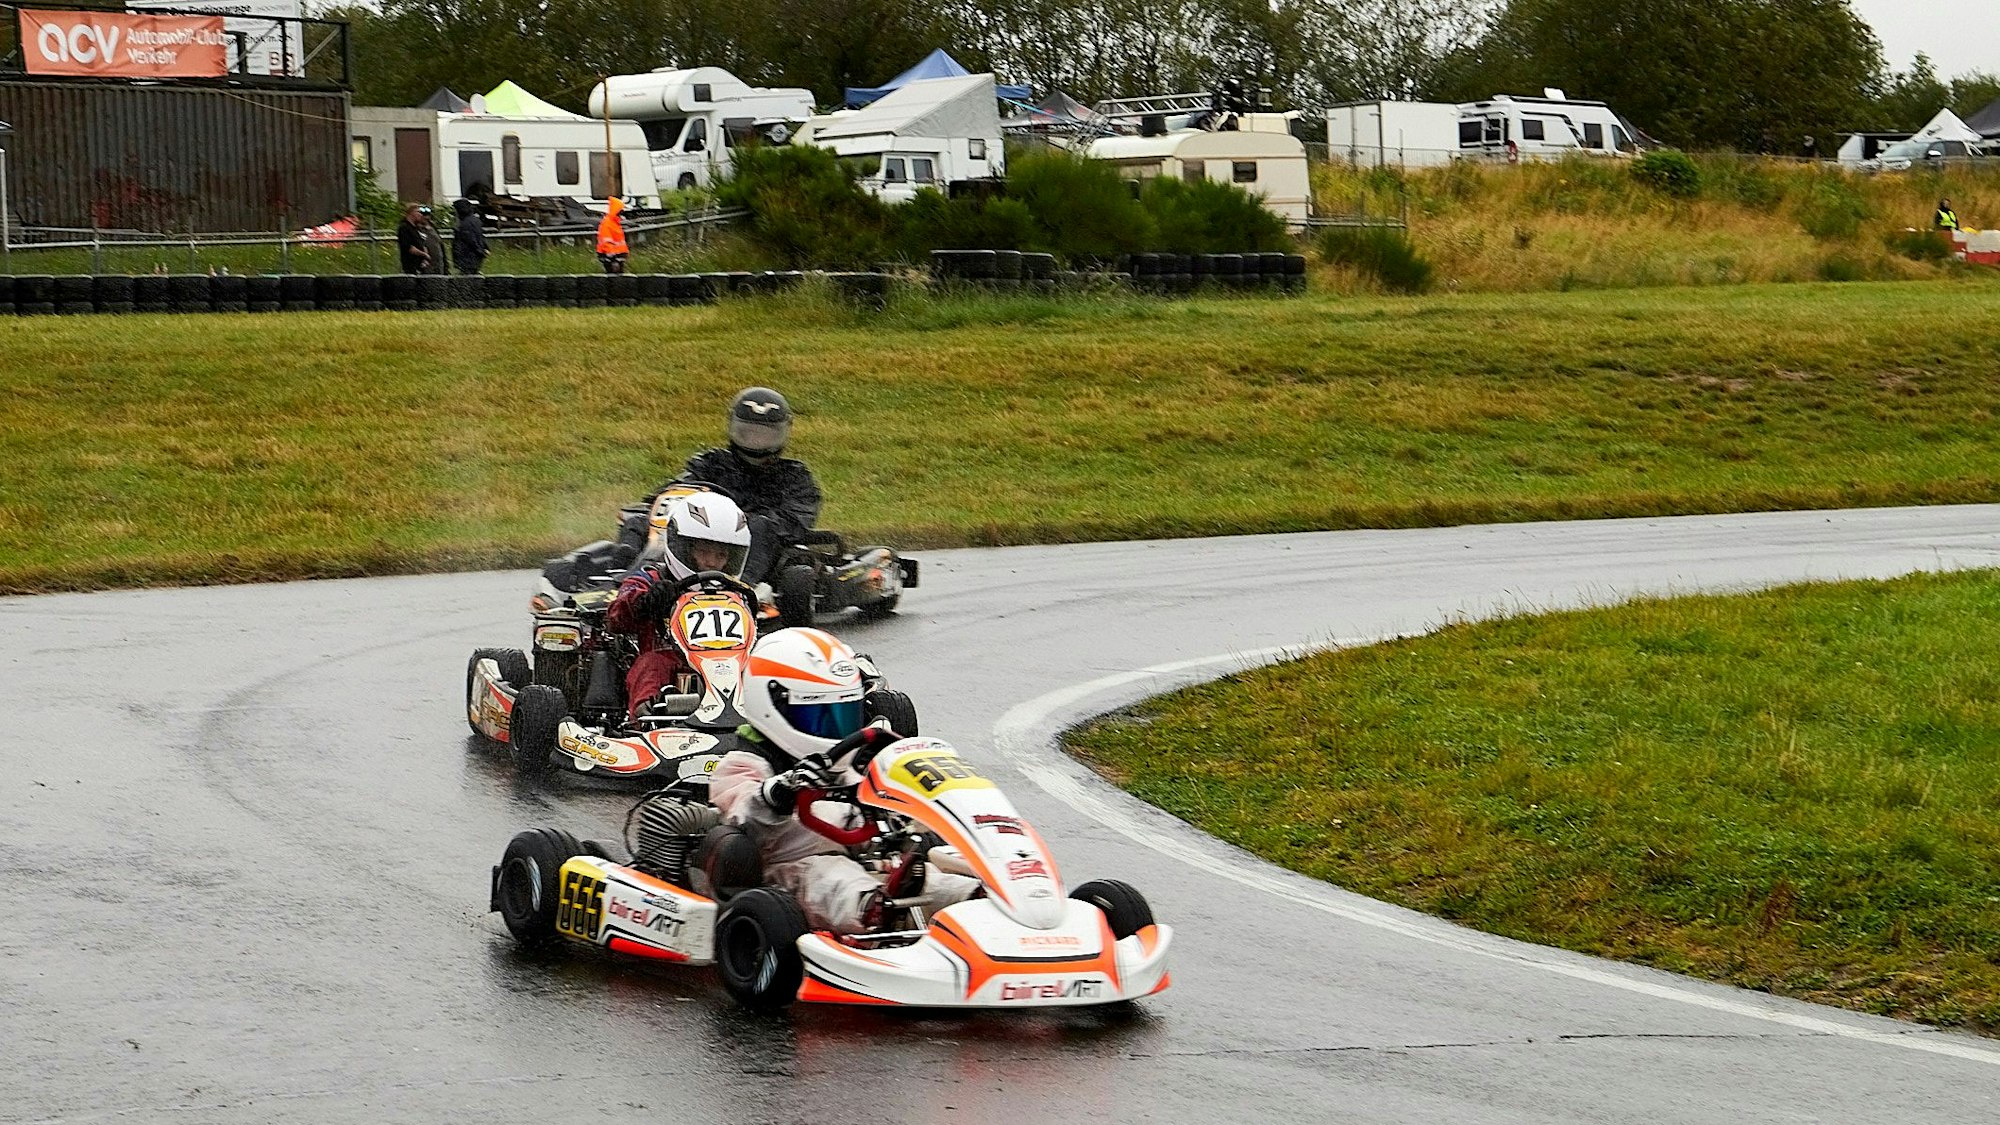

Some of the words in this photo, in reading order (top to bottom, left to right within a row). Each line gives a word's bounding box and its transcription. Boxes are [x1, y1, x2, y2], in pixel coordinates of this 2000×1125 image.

[126, 27, 229, 47] Automobil-Club
[126, 47, 178, 65] Verkehr
[687, 609, 743, 640] 212
[560, 871, 607, 940] 555
